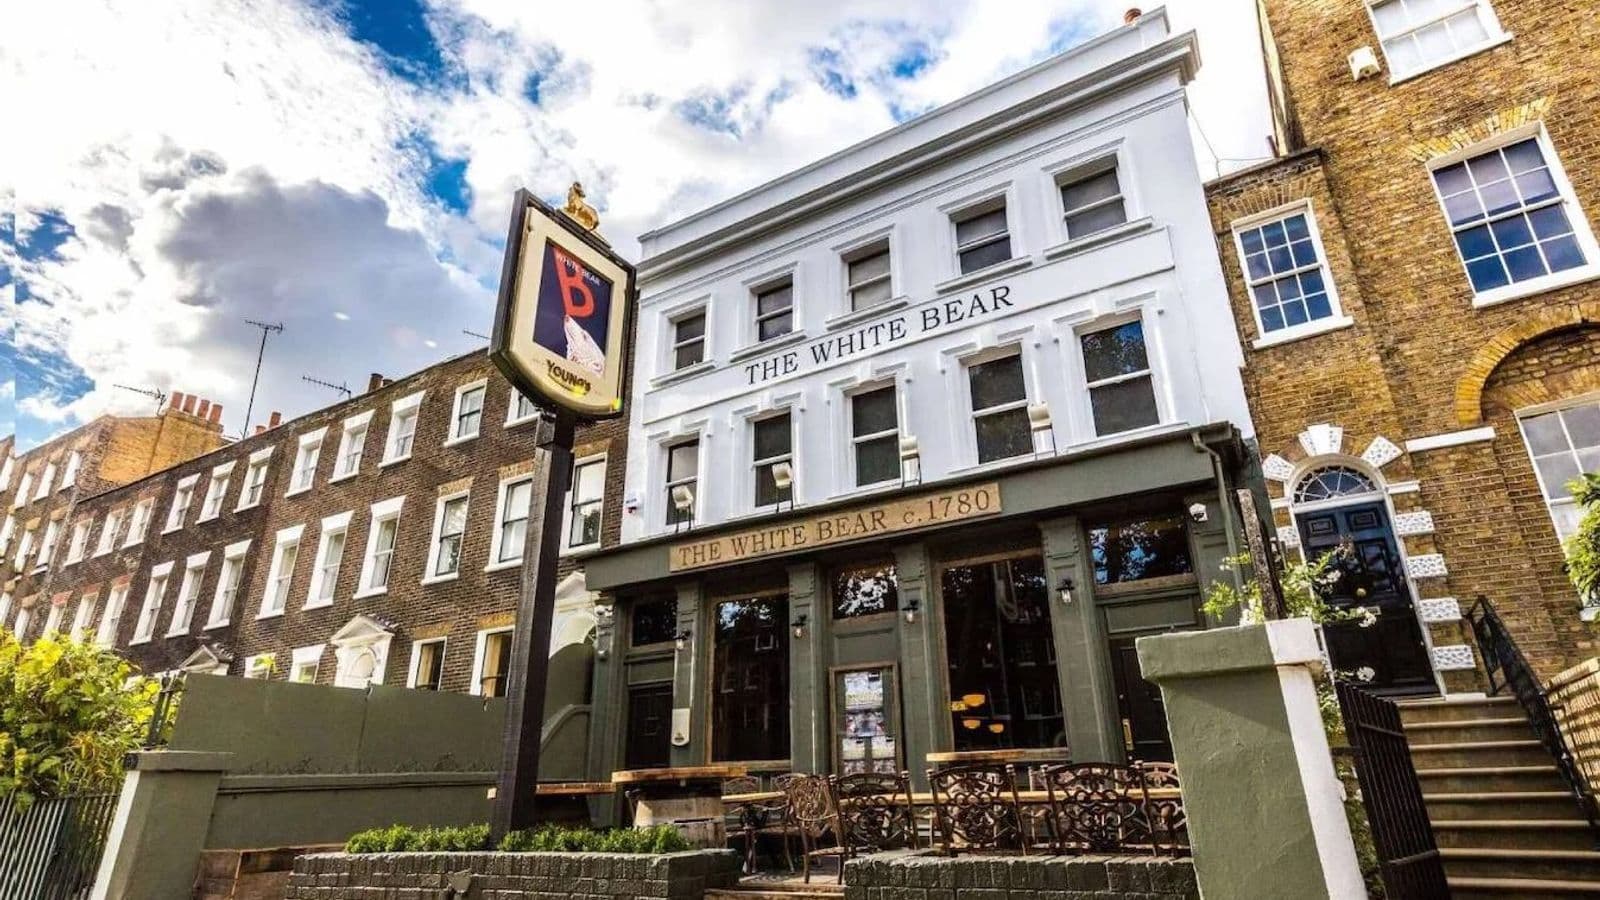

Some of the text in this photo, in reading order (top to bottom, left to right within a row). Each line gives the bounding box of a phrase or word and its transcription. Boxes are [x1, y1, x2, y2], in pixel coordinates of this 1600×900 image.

[745, 285, 1013, 385] THE WHITE BEAR
[679, 541, 721, 566] THE
[731, 525, 806, 556] WHITE
[817, 509, 888, 541] BEAR
